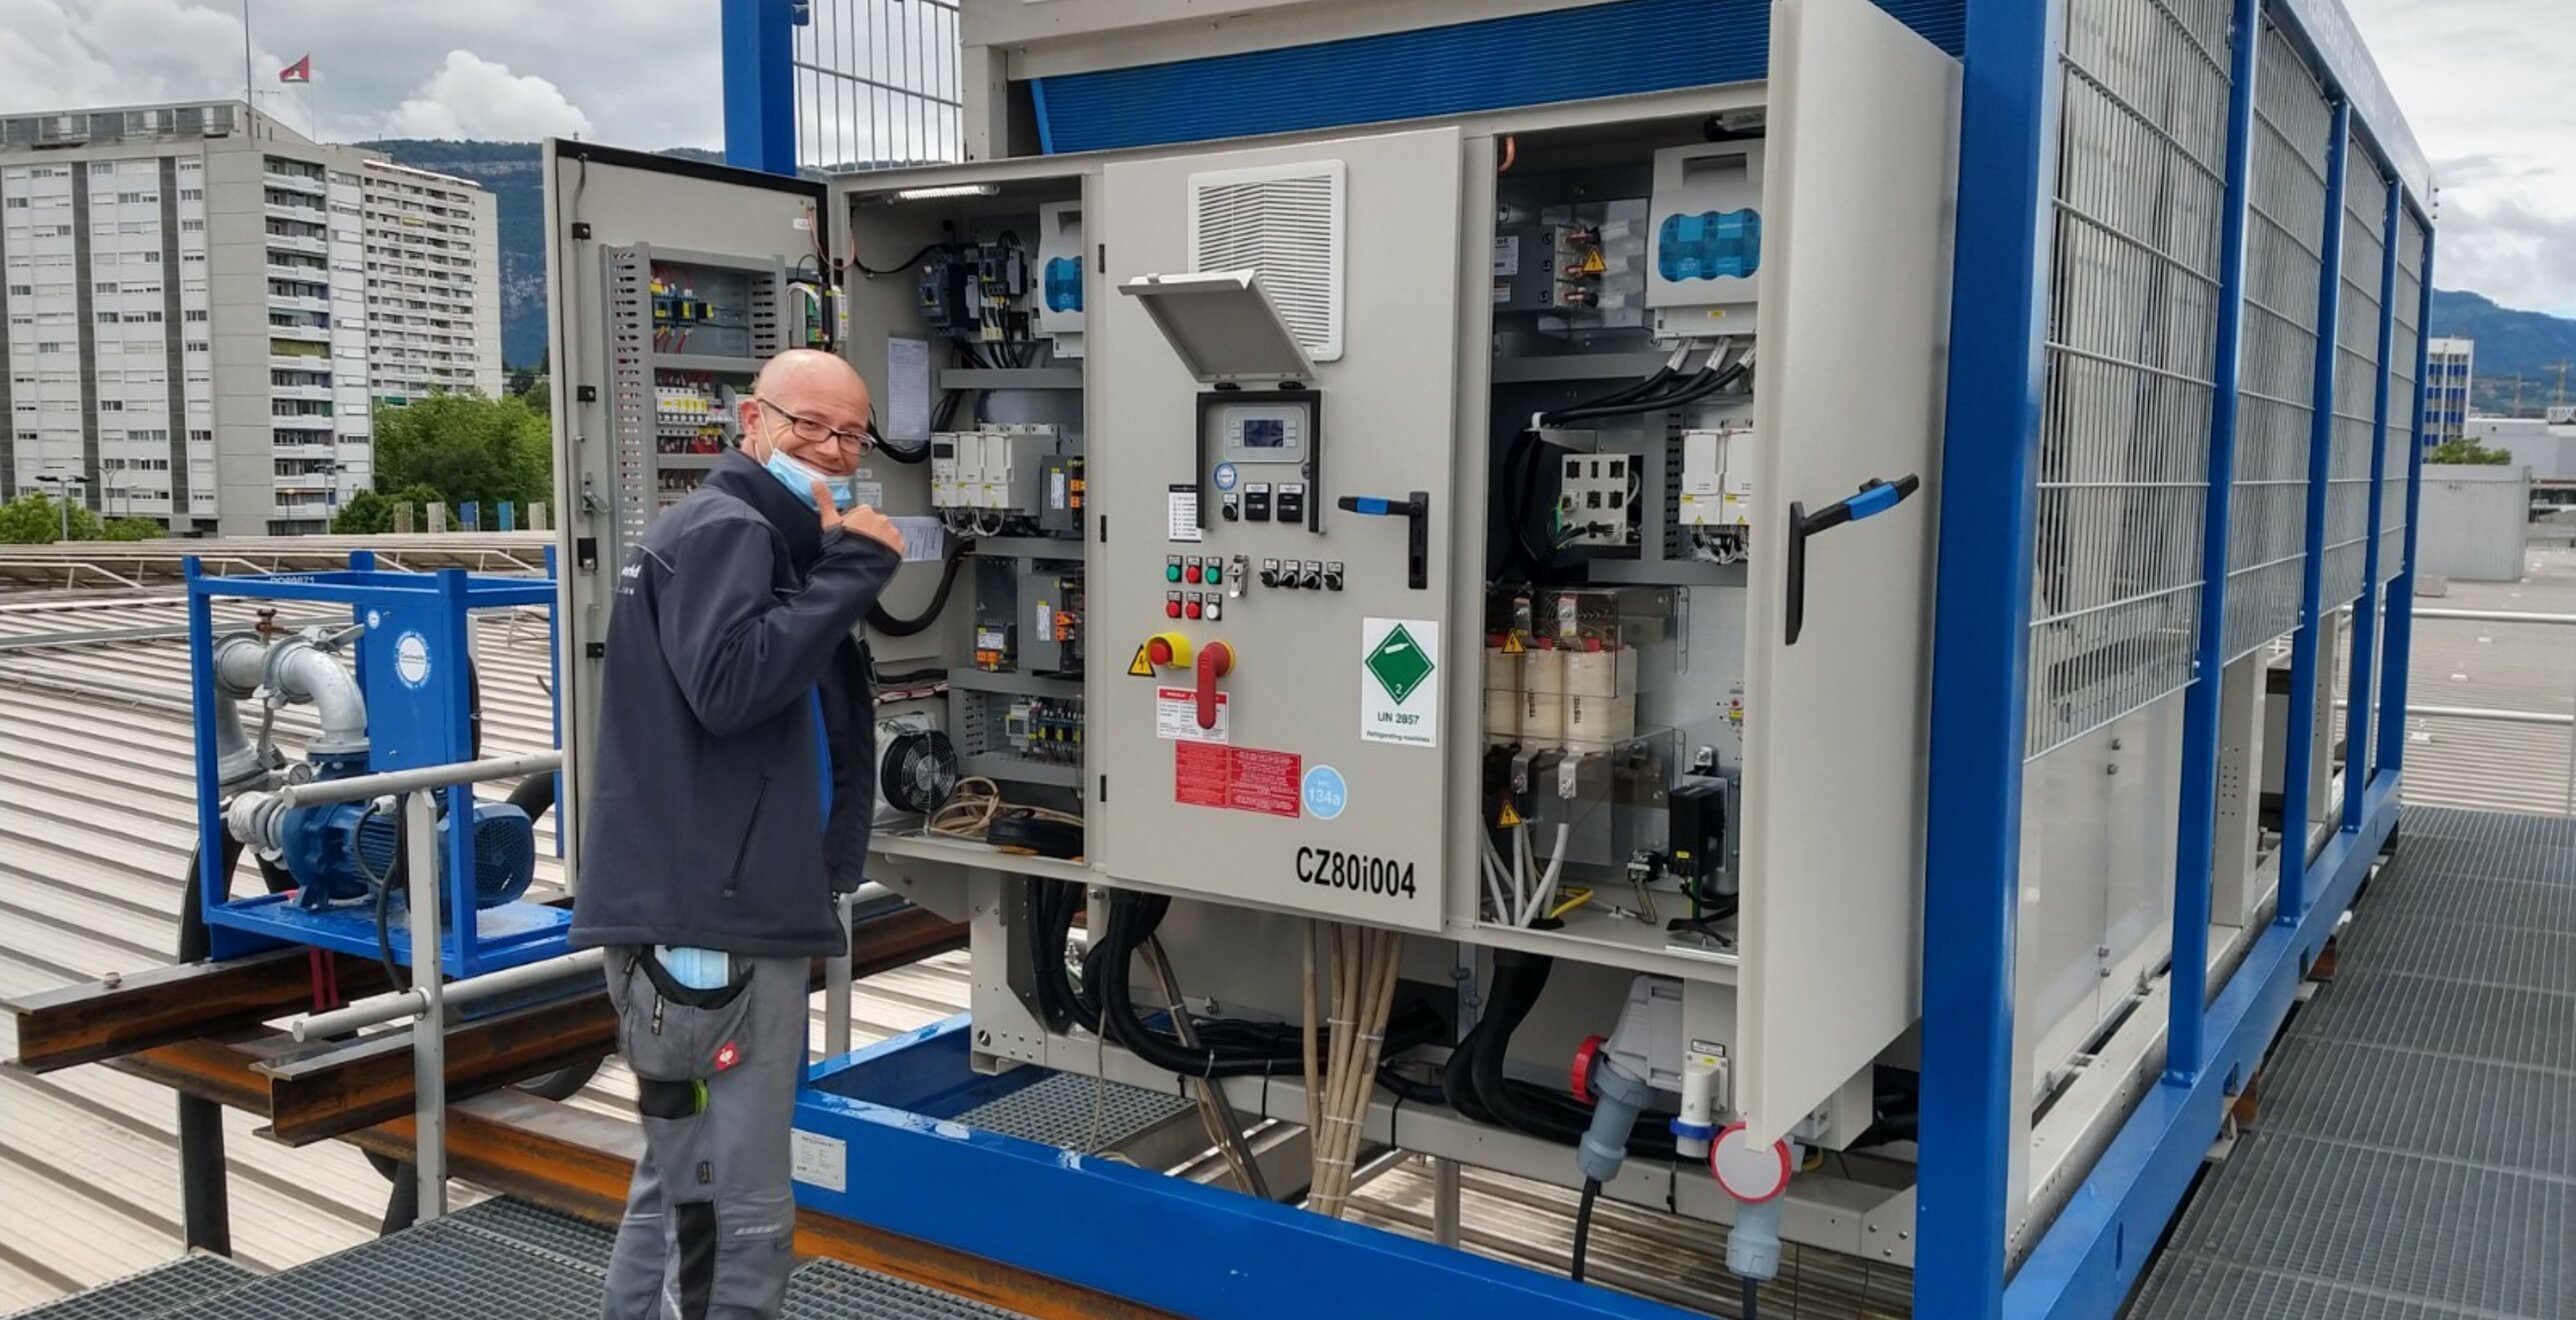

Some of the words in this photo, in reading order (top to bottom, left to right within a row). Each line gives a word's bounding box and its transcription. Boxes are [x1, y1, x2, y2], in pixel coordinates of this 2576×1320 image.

[1395, 683, 1403, 695] 2
[1377, 711, 1393, 723] UN
[1395, 713, 1420, 725] 2857
[1308, 787, 1341, 806] 134a
[1296, 846, 1416, 899] CZ80i004
